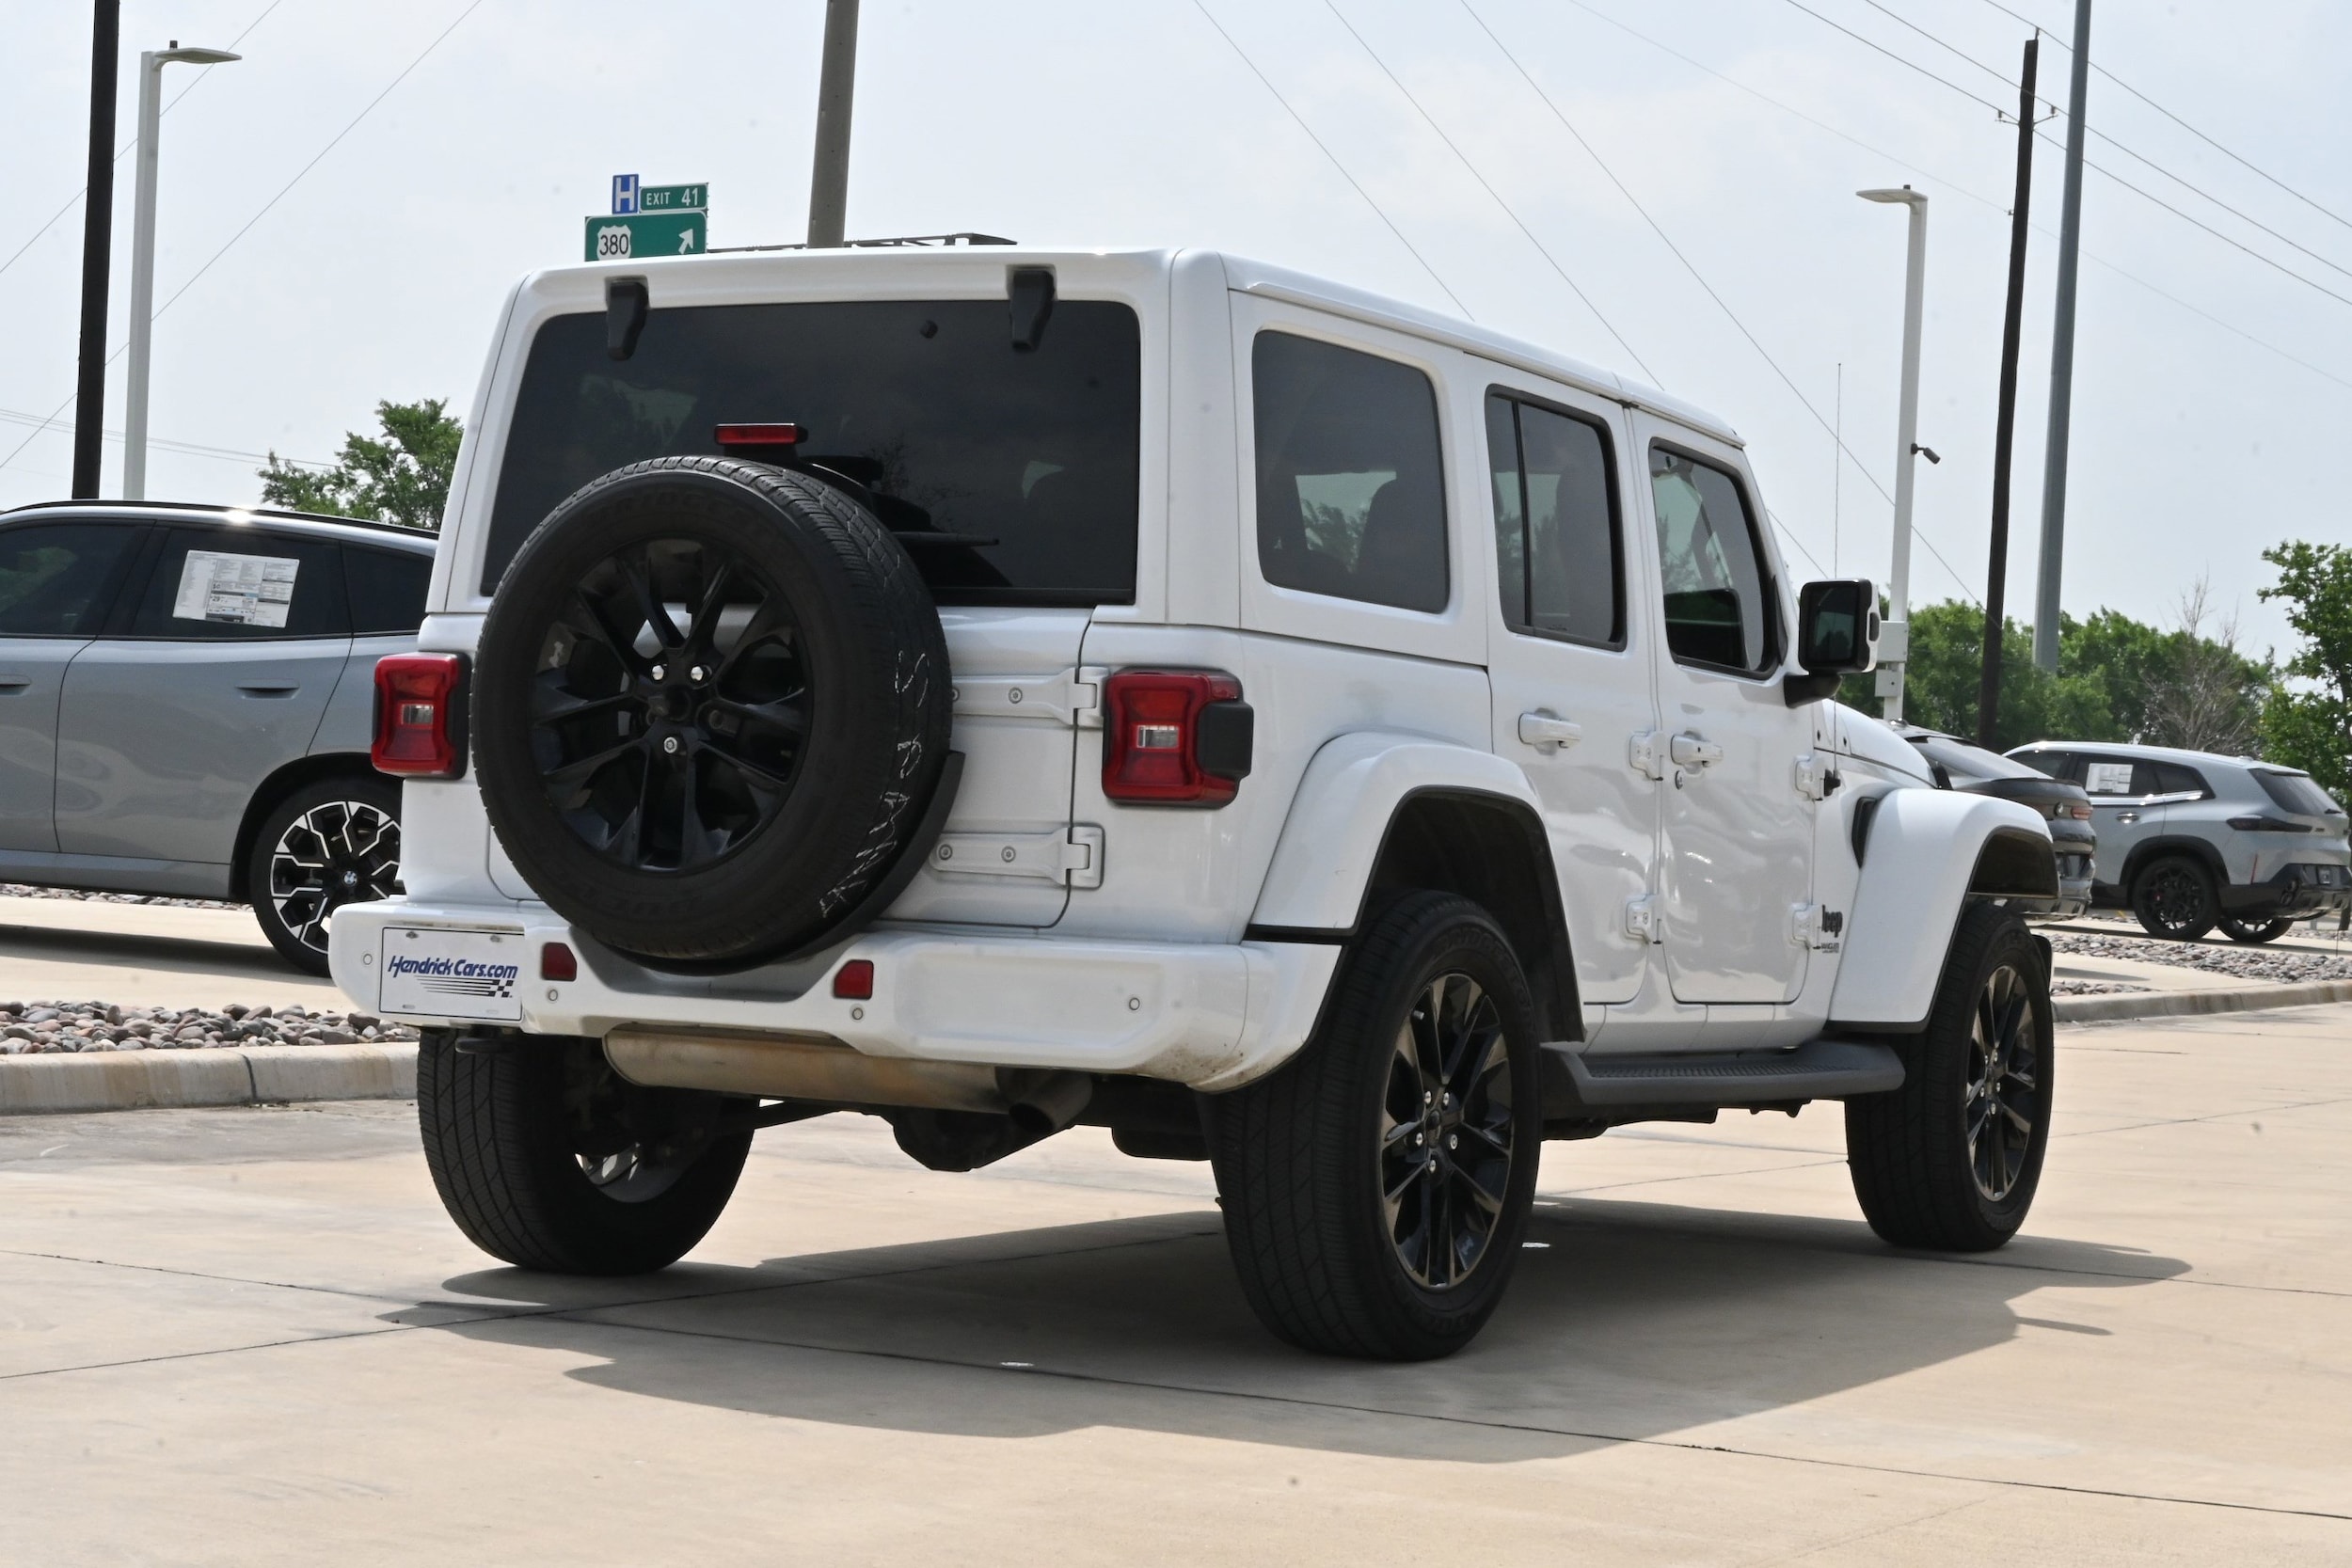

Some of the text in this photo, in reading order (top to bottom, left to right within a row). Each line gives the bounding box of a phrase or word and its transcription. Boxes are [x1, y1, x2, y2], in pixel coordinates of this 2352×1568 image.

[614, 175, 636, 213] H
[645, 187, 699, 206] EXIT 41
[599, 233, 629, 256] 380
[1821, 904, 1843, 938] Jeep
[388, 955, 519, 979] HendrickCars.com
